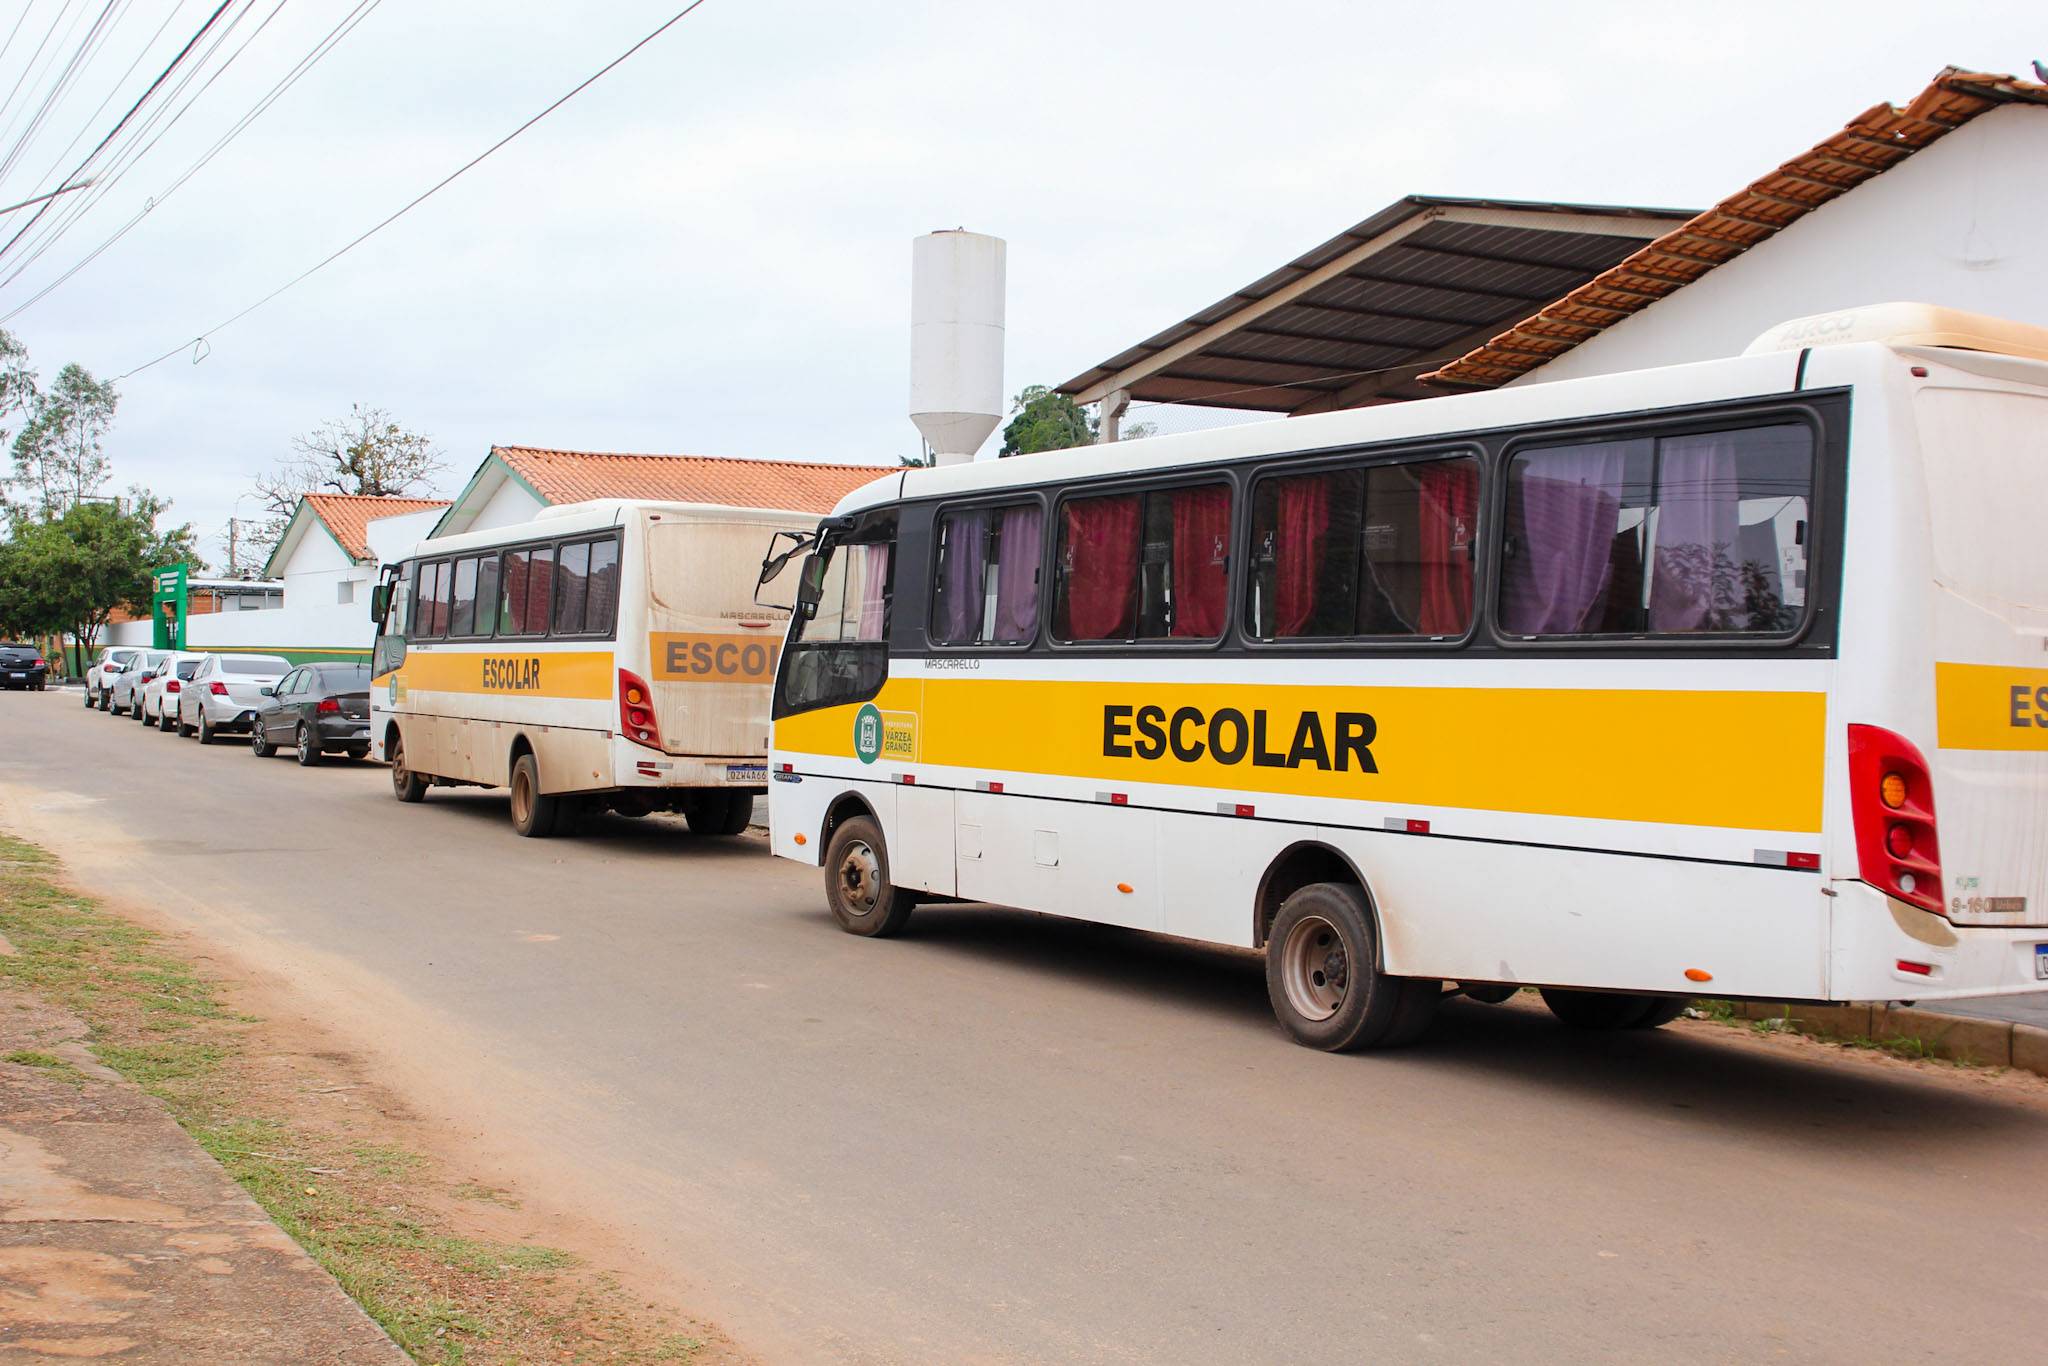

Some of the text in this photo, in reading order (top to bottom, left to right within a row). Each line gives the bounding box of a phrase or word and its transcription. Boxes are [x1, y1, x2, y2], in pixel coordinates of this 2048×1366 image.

[720, 611, 791, 621] MASCARELLO
[925, 659, 980, 670] MASCARELLO
[483, 659, 540, 689] ESCOLAR
[1103, 704, 1379, 774] ESCOLAR
[885, 741, 912, 753] GRANDE
